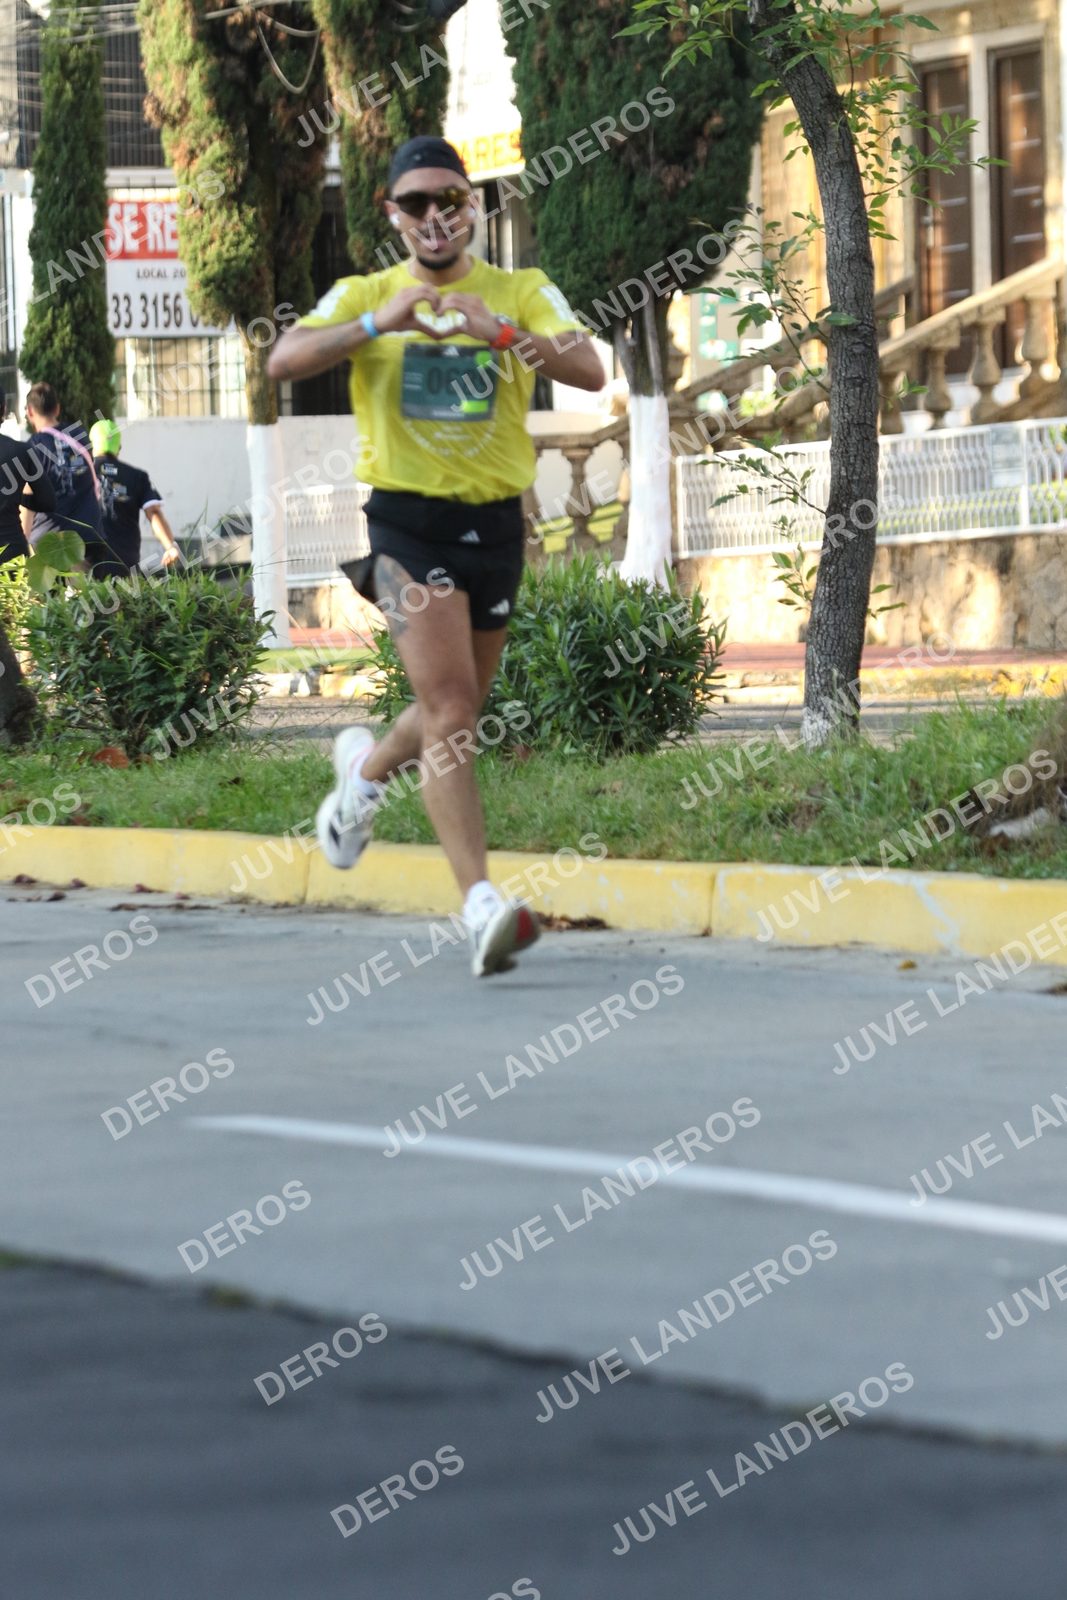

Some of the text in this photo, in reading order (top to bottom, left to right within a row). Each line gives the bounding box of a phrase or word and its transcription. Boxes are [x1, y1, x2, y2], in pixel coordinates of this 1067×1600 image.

[108, 203, 179, 252] SE RE
[136, 268, 169, 280] LOCAL
[112, 293, 133, 329] 33
[140, 293, 183, 329] 3156
